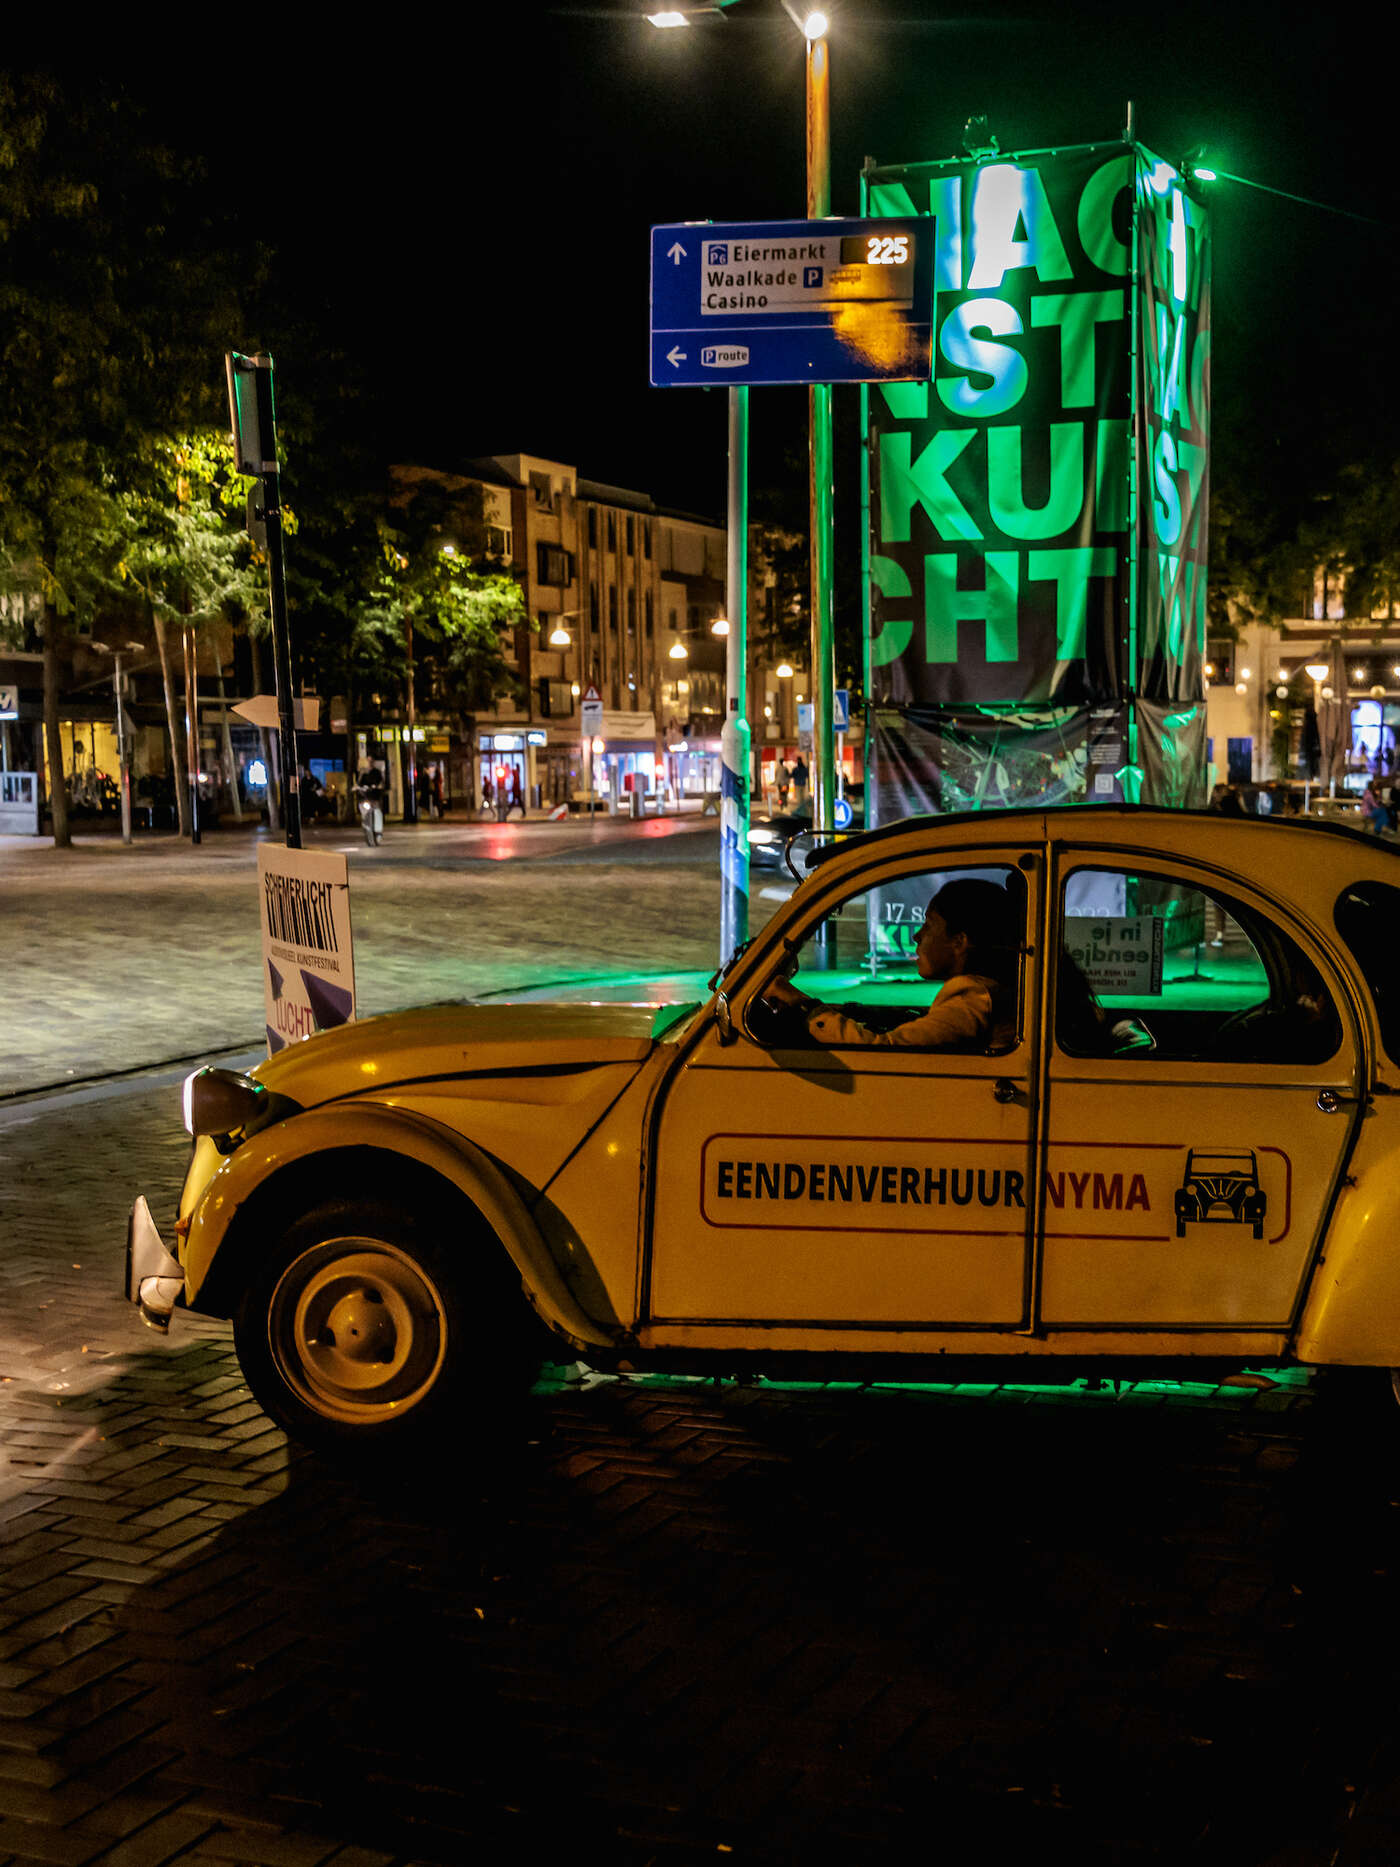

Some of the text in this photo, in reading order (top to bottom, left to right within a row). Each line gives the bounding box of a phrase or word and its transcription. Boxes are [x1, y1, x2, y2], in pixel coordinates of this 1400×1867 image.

[734, 244, 826, 262] Eiermarkt
[867, 237, 908, 264] 225
[707, 269, 797, 287] Waalkade
[707, 292, 768, 309] Casino
[718, 350, 747, 361] route
[718, 1161, 1152, 1211] EENDENVERHUUR NYMA
